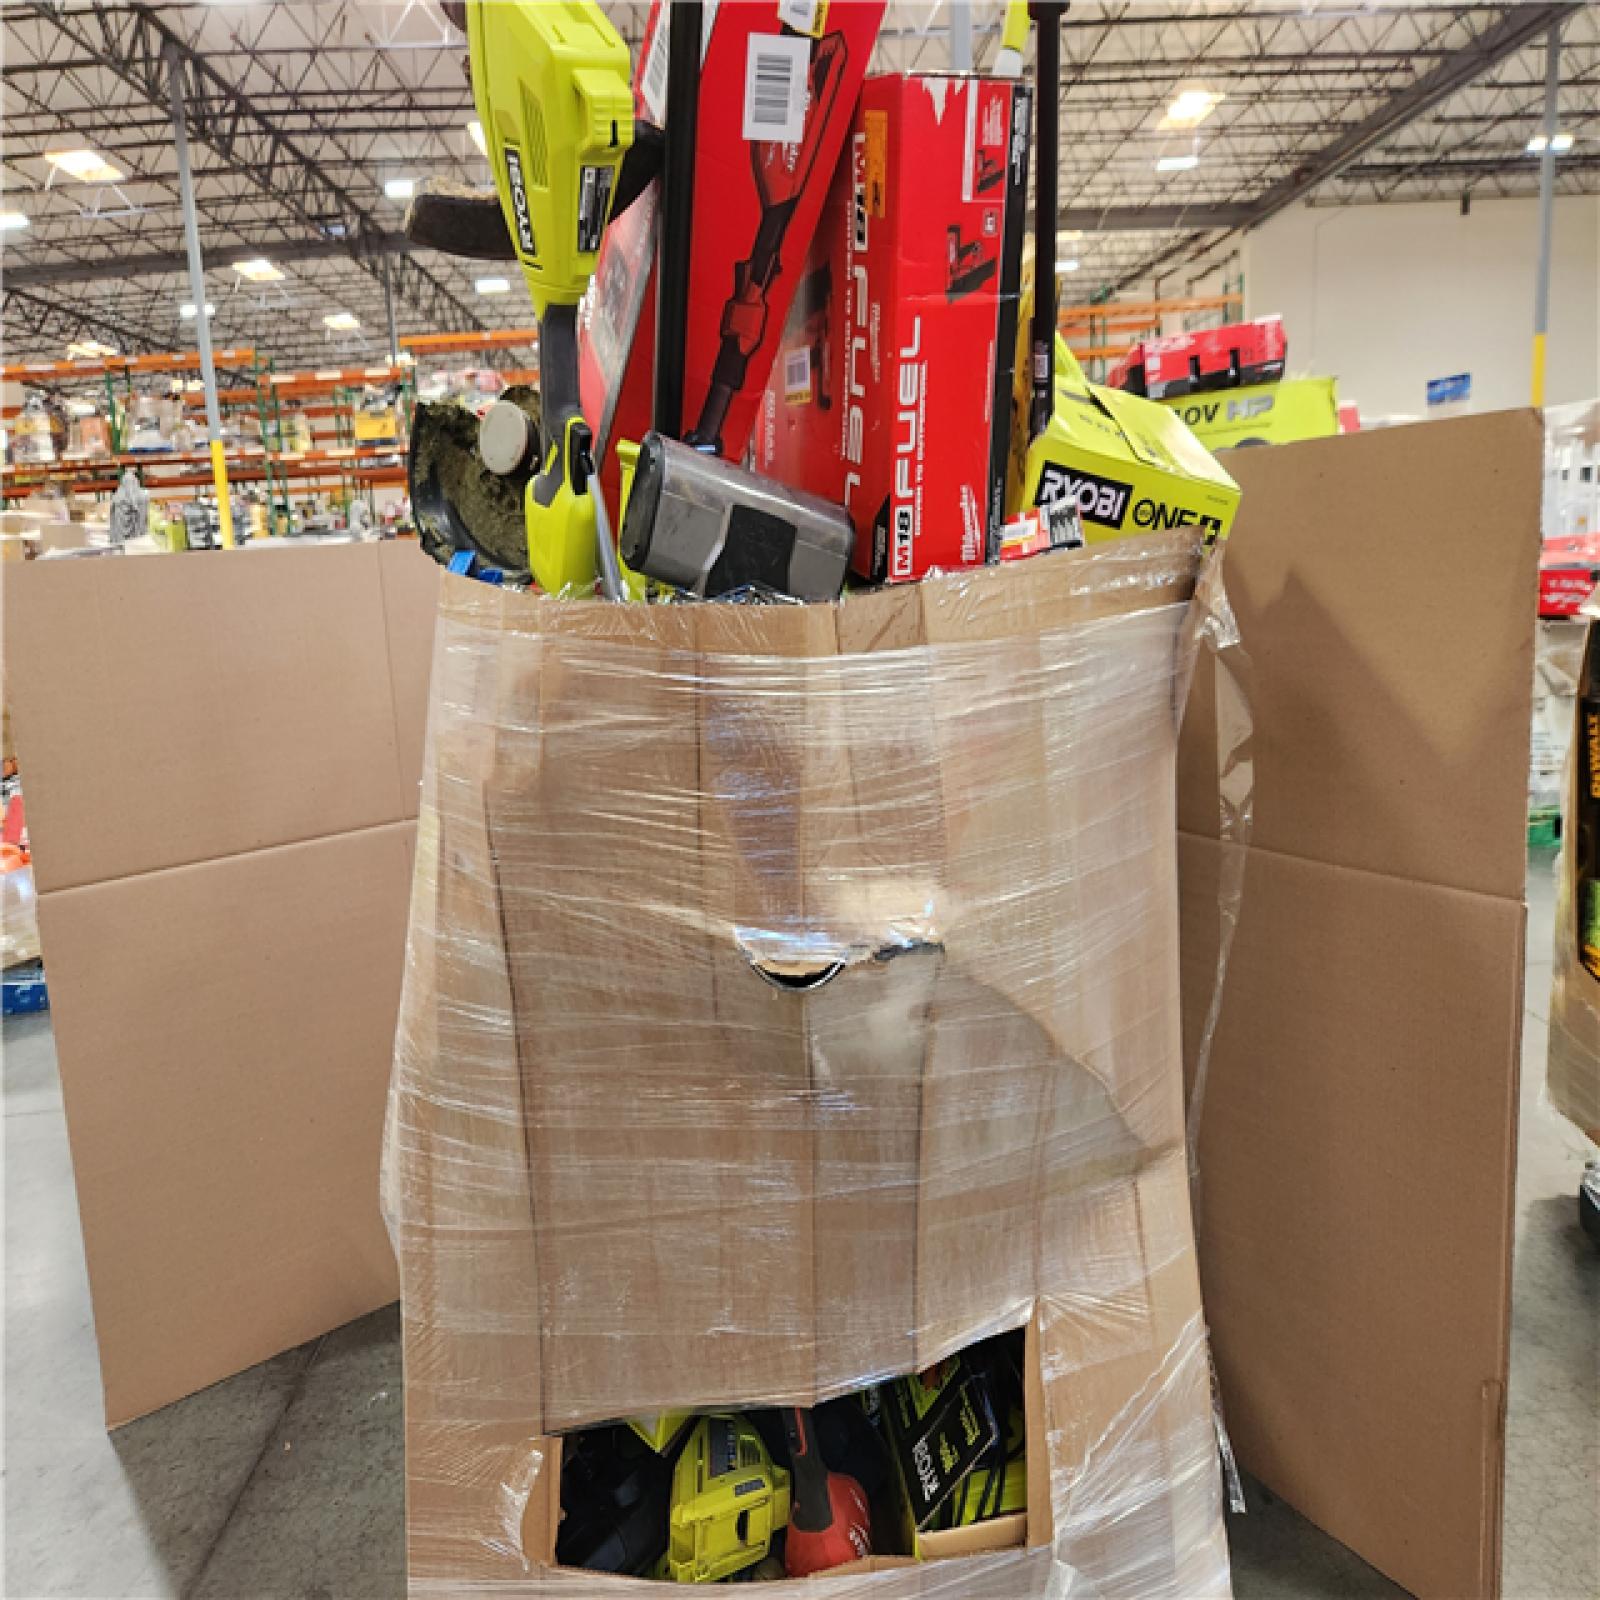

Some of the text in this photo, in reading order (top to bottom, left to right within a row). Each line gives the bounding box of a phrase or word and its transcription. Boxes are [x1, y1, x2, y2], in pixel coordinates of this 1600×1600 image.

[1174, 401, 1221, 425] 0V
[894, 316, 921, 574] M18 FUEL
[1040, 468, 1127, 521] RYOBI
